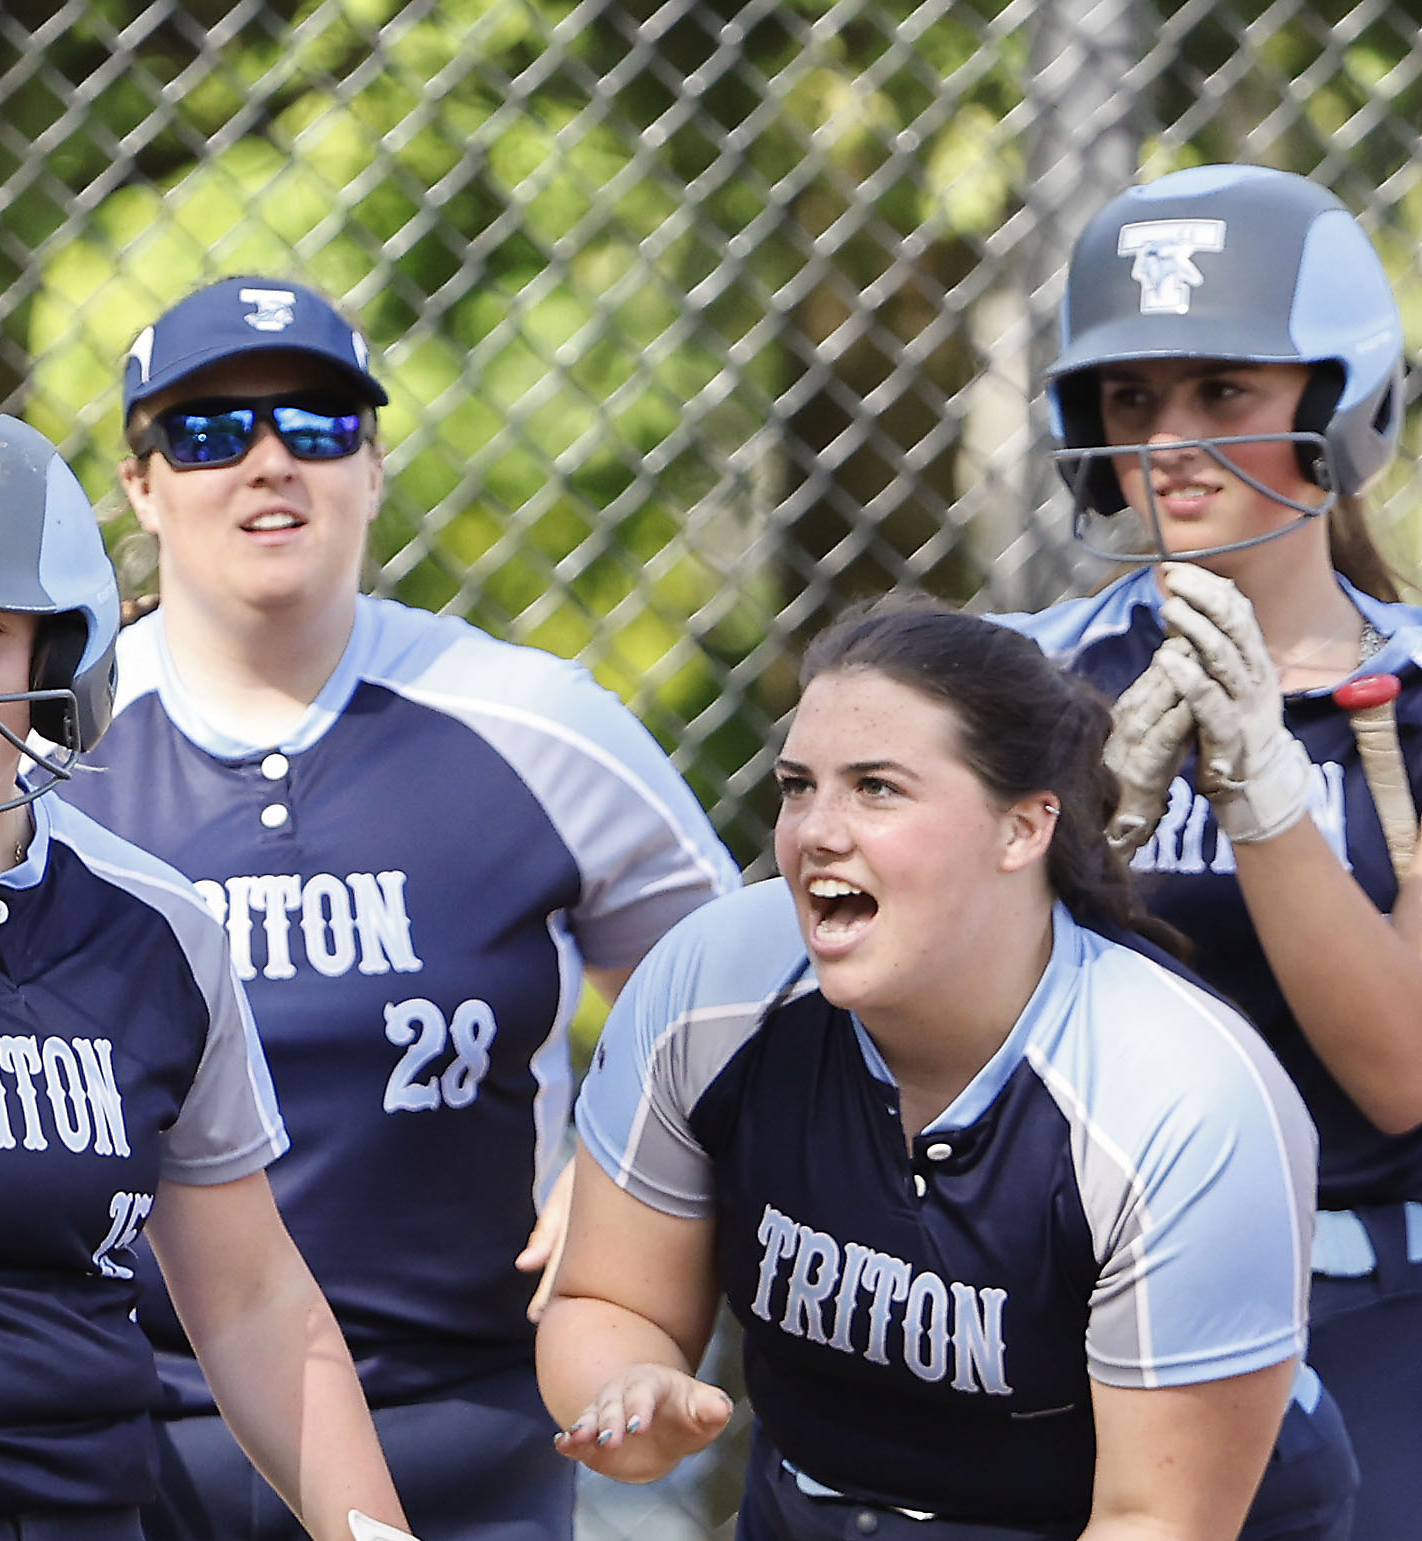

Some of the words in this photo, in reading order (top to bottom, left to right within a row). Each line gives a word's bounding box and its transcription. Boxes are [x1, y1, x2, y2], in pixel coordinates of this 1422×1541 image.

[191, 869, 424, 982] ITON
[382, 997, 497, 1114] 28
[750, 1203, 1014, 1395] TRITON
